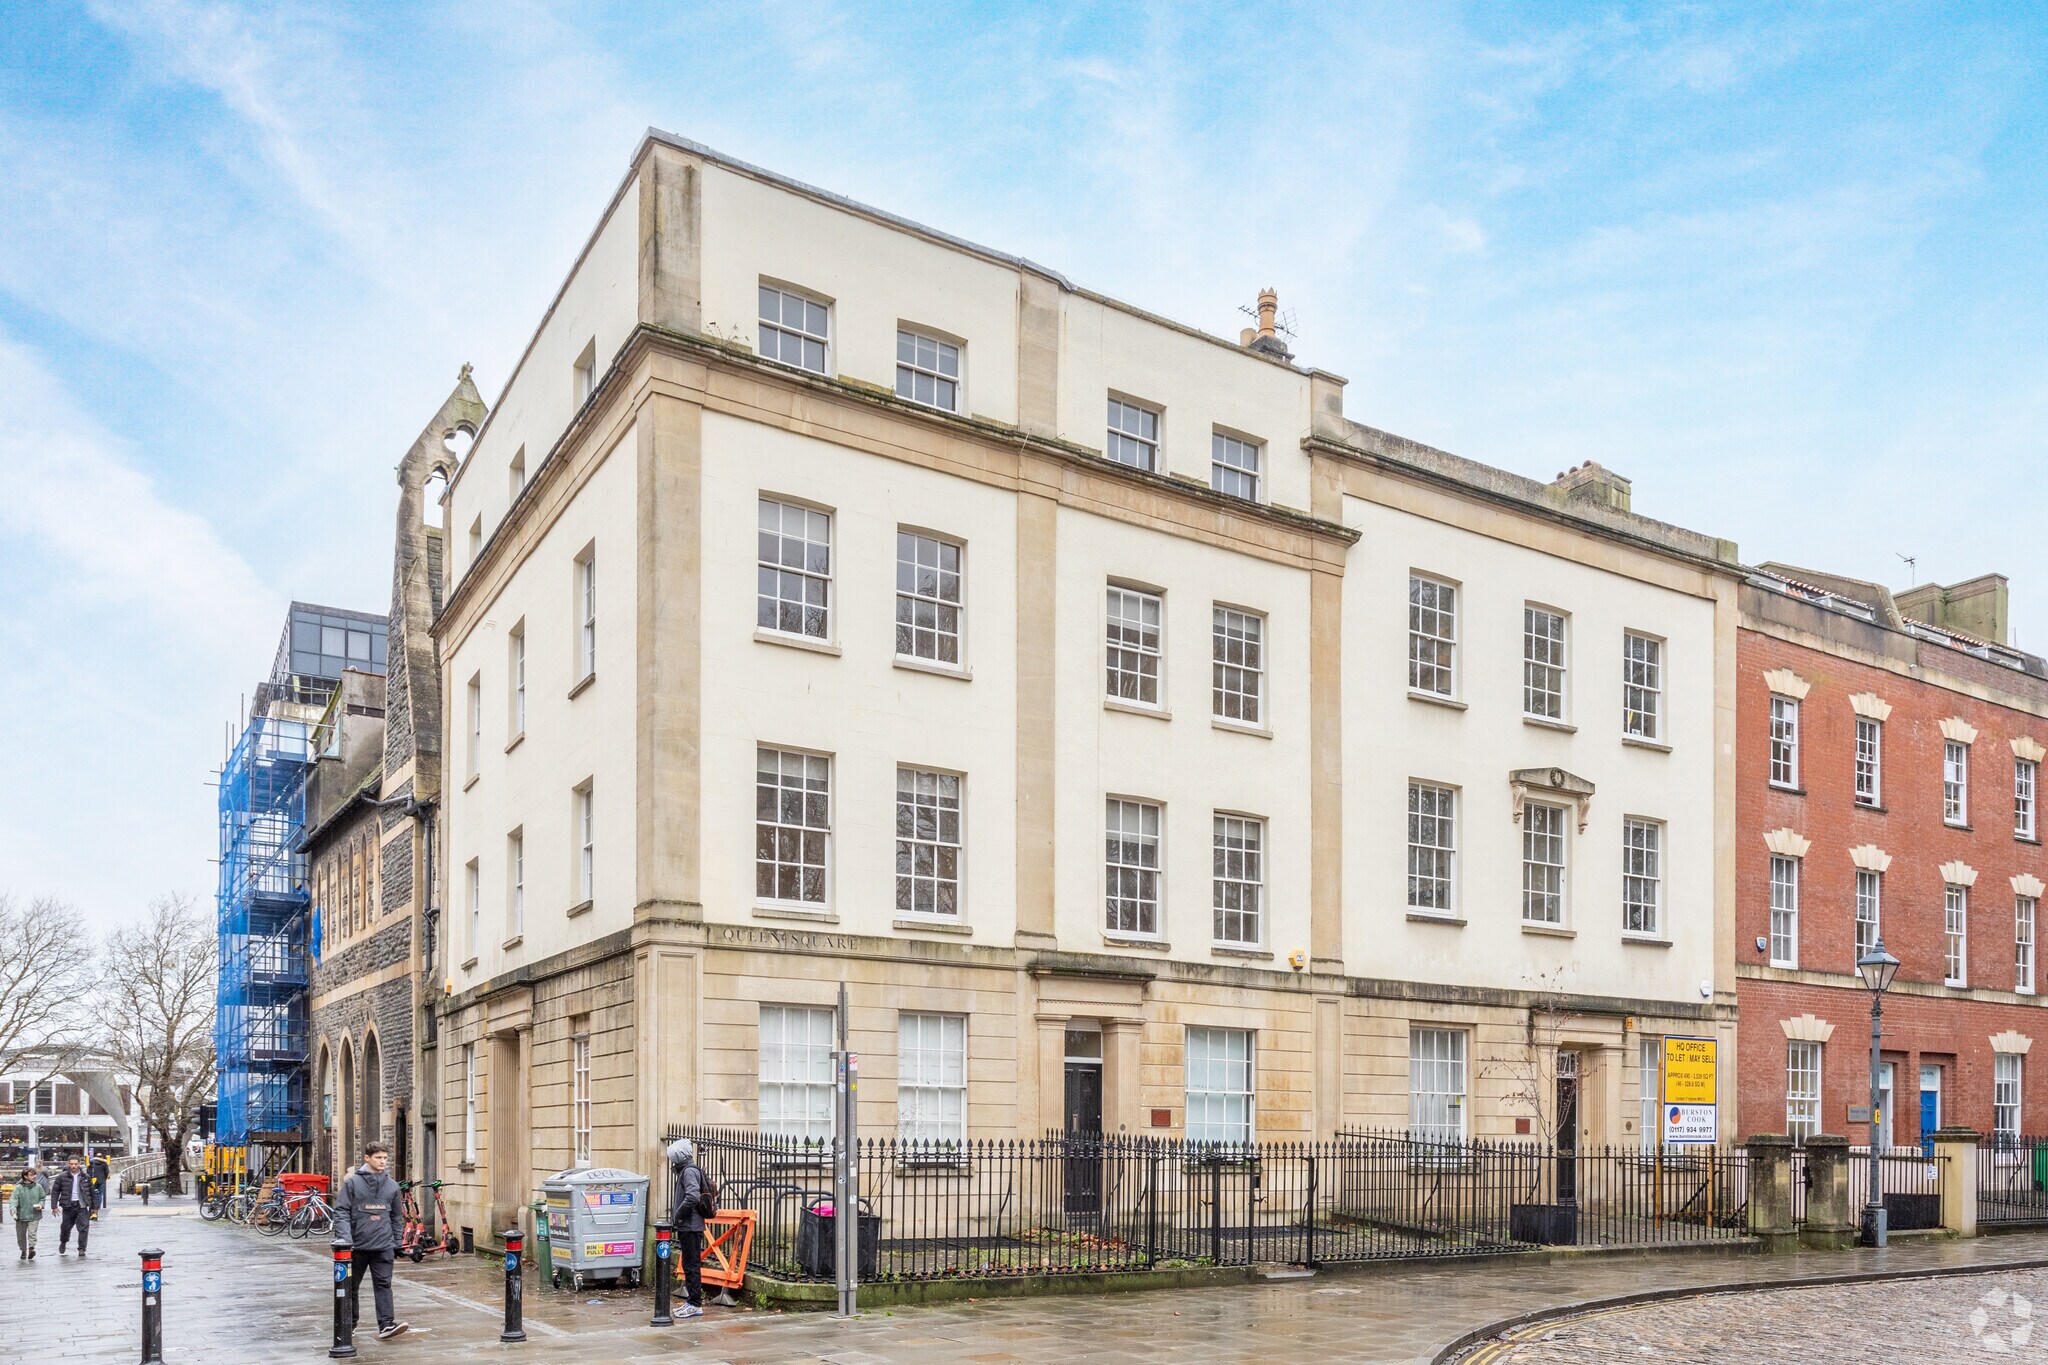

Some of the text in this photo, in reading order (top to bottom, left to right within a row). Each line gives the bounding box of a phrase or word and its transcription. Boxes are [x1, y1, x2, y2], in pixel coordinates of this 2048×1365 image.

[723, 928, 858, 950] QUEEN SQUARE
[1676, 1042, 1705, 1052] HQ OFFICE
[1667, 1053, 1674, 1061] TO
[1702, 1055, 1714, 1063] SELL
